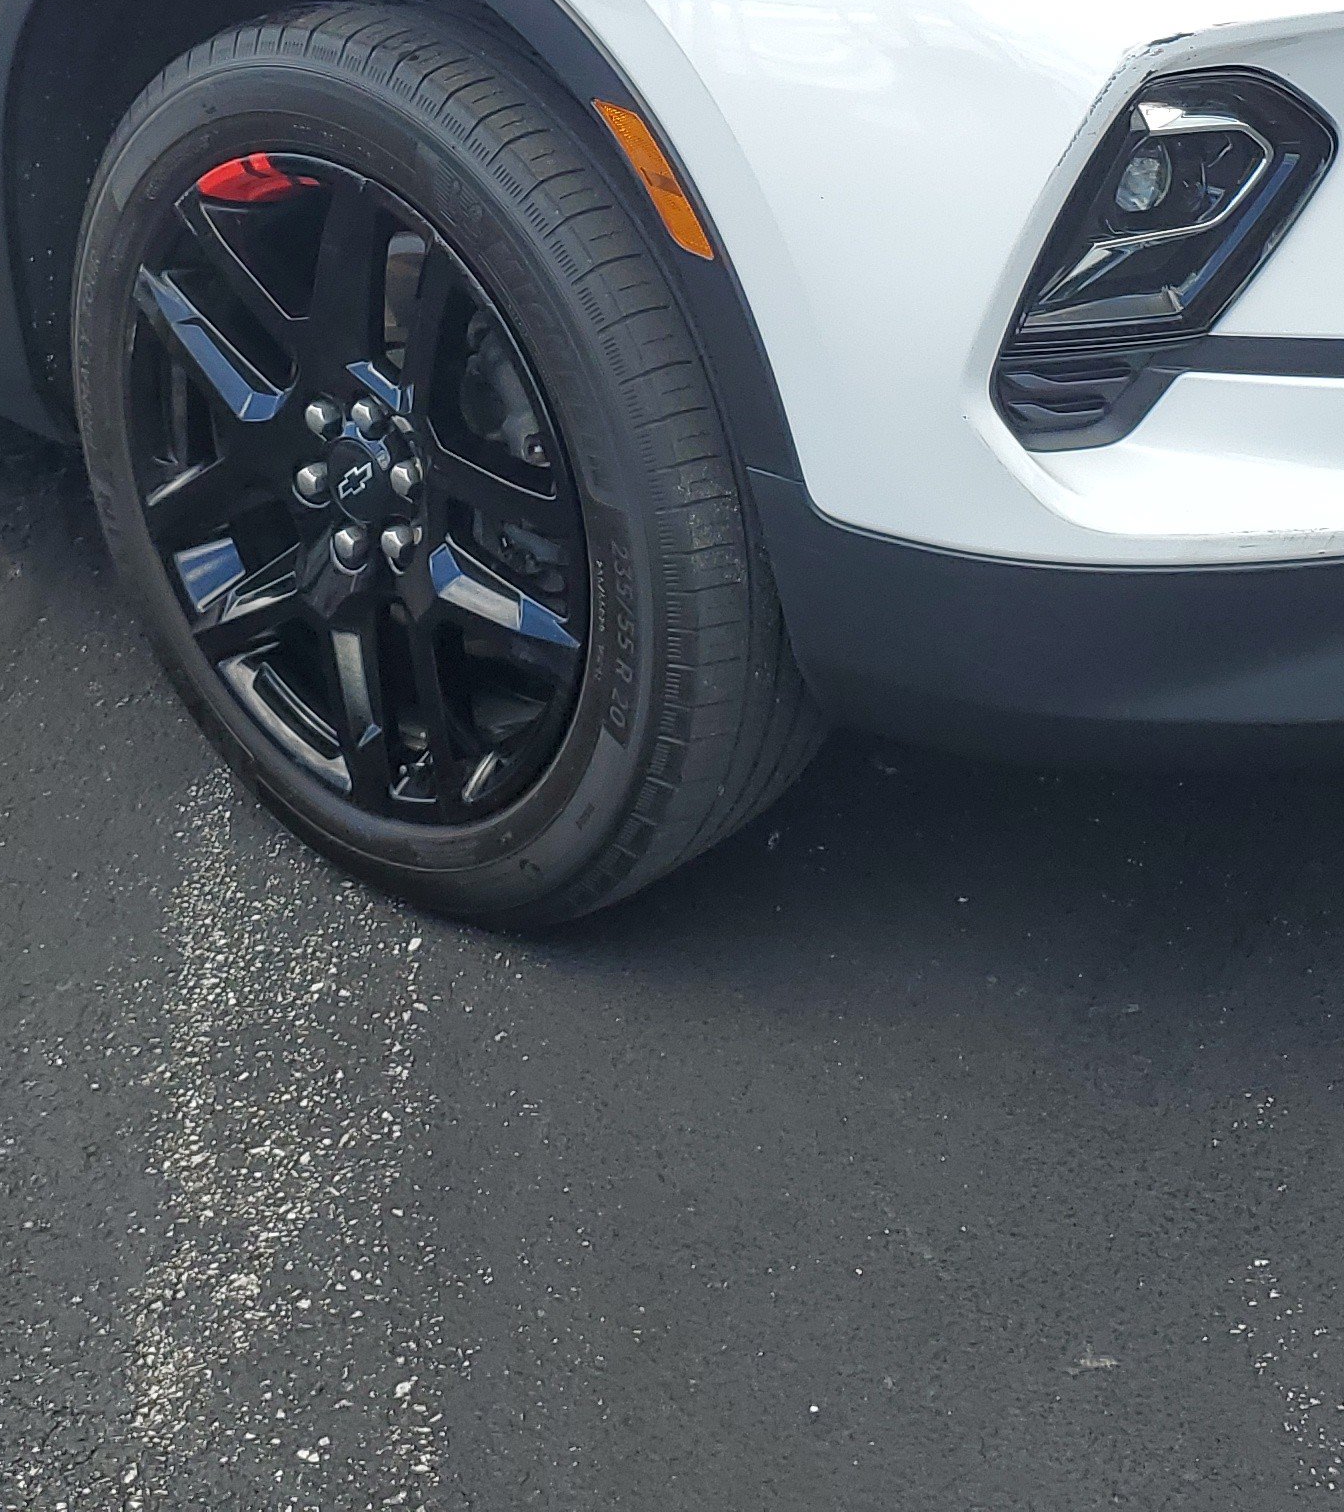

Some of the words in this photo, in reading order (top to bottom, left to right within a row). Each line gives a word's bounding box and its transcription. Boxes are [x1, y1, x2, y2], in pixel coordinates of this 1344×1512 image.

[610, 540, 636, 651] 235/55
[614, 656, 634, 684] R
[608, 687, 630, 729] 20
